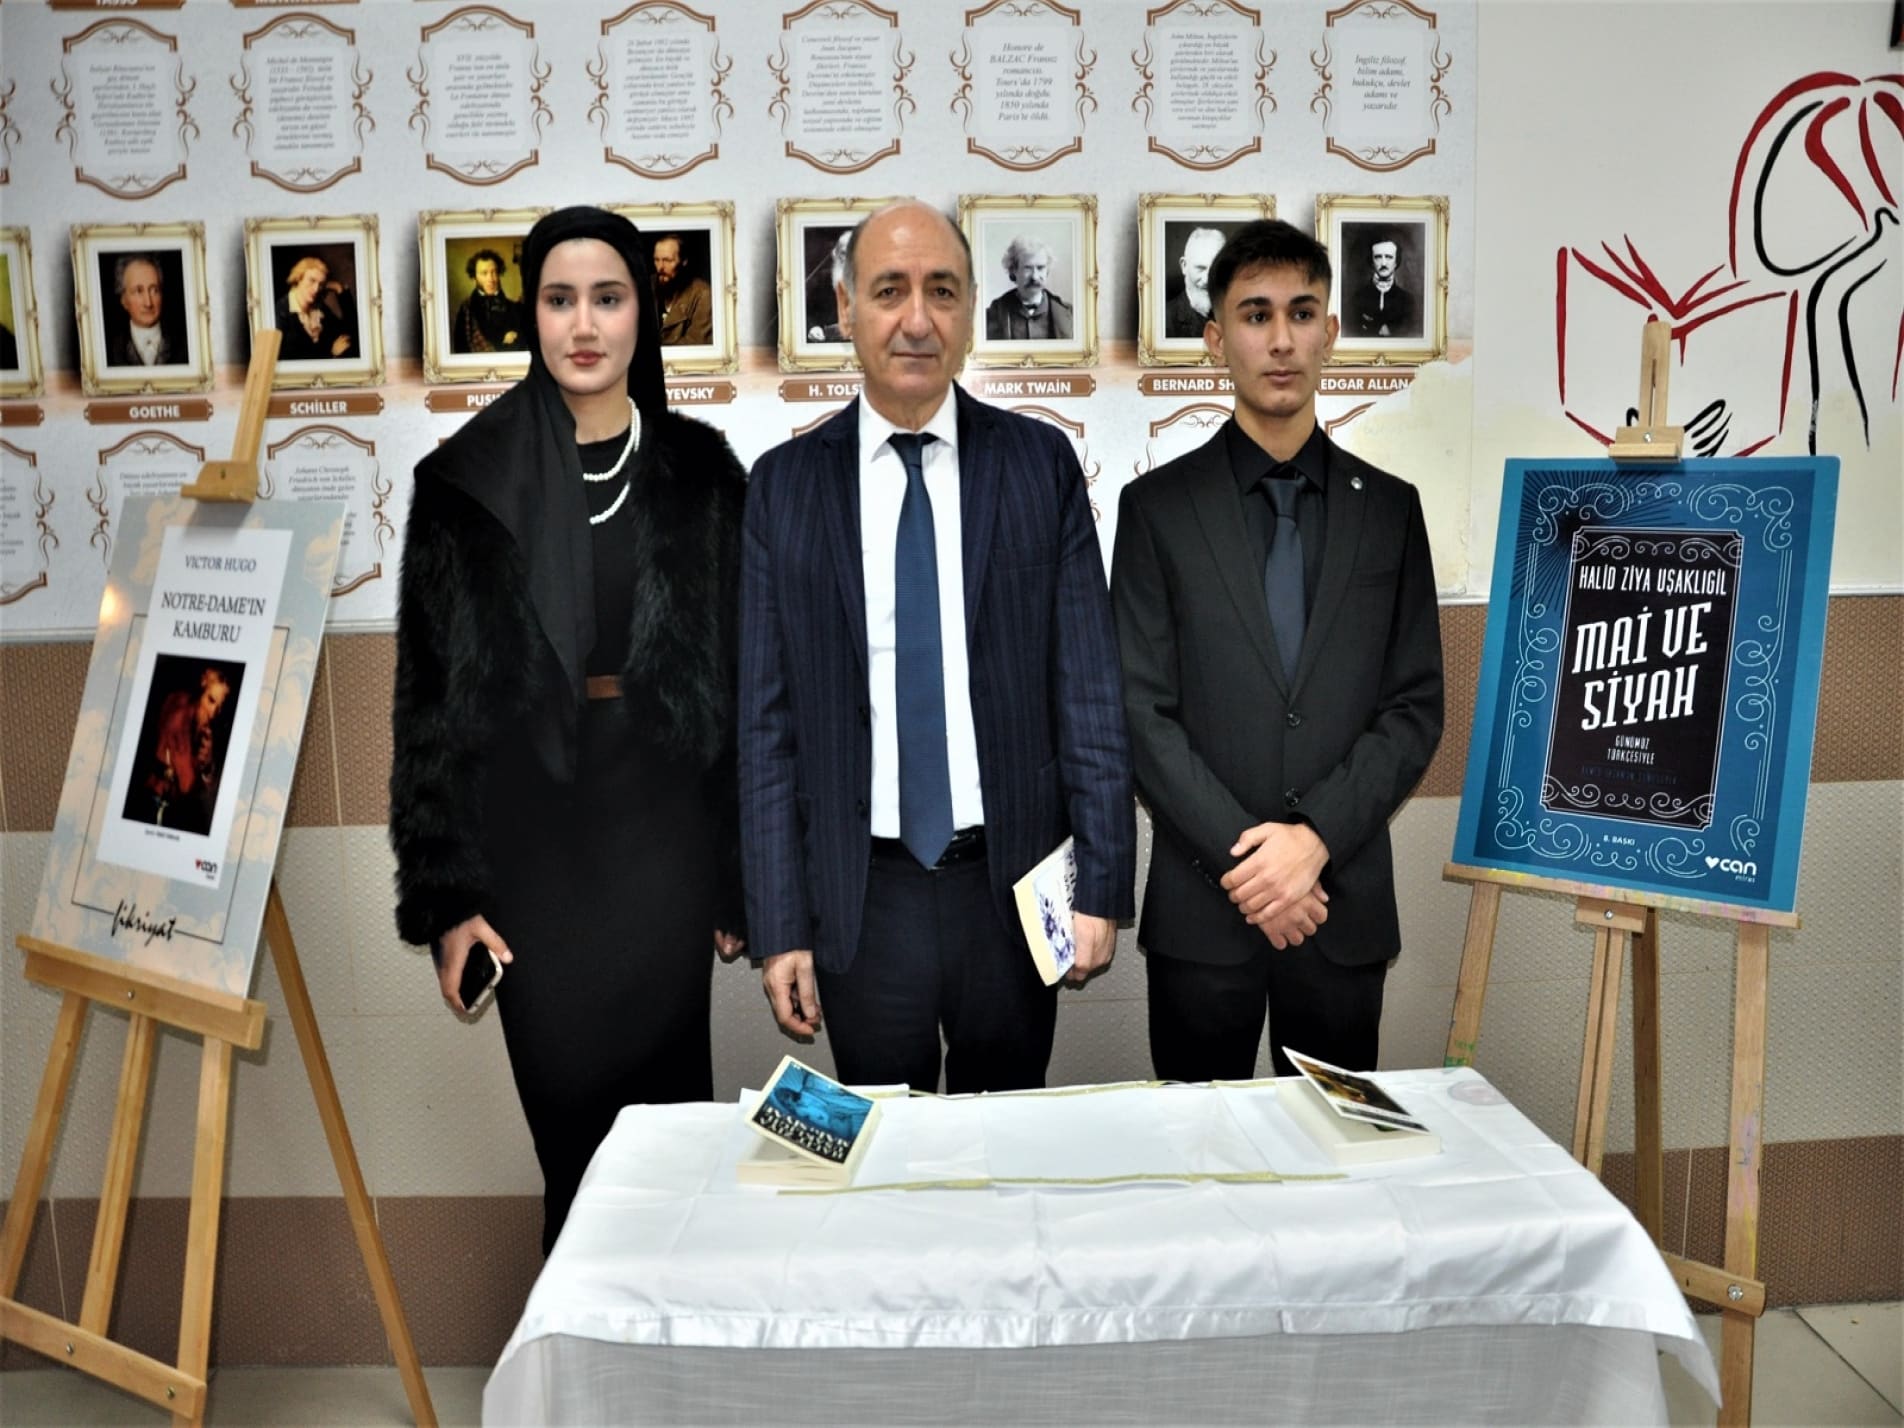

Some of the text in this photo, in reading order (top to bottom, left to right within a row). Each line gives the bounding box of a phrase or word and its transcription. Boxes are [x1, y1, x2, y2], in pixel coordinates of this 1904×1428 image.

[808, 384, 823, 397] H.
[984, 382, 1023, 394] MARK
[1153, 378, 1235, 391] BERNARD SH
[1320, 378, 1409, 391] EDGAR ALLAN
[665, 386, 715, 401] YEVSKY
[129, 405, 180, 418] GOETHE
[185, 555, 257, 572] VICTOR HUGO
[1579, 564, 1616, 590] HALİD
[1621, 565, 1651, 592] ZİYA
[172, 620, 242, 643] KAMBURU
[1571, 602, 1712, 674] MAİ VE
[1581, 664, 1699, 730] SİYAH
[1719, 858, 1757, 876] can
